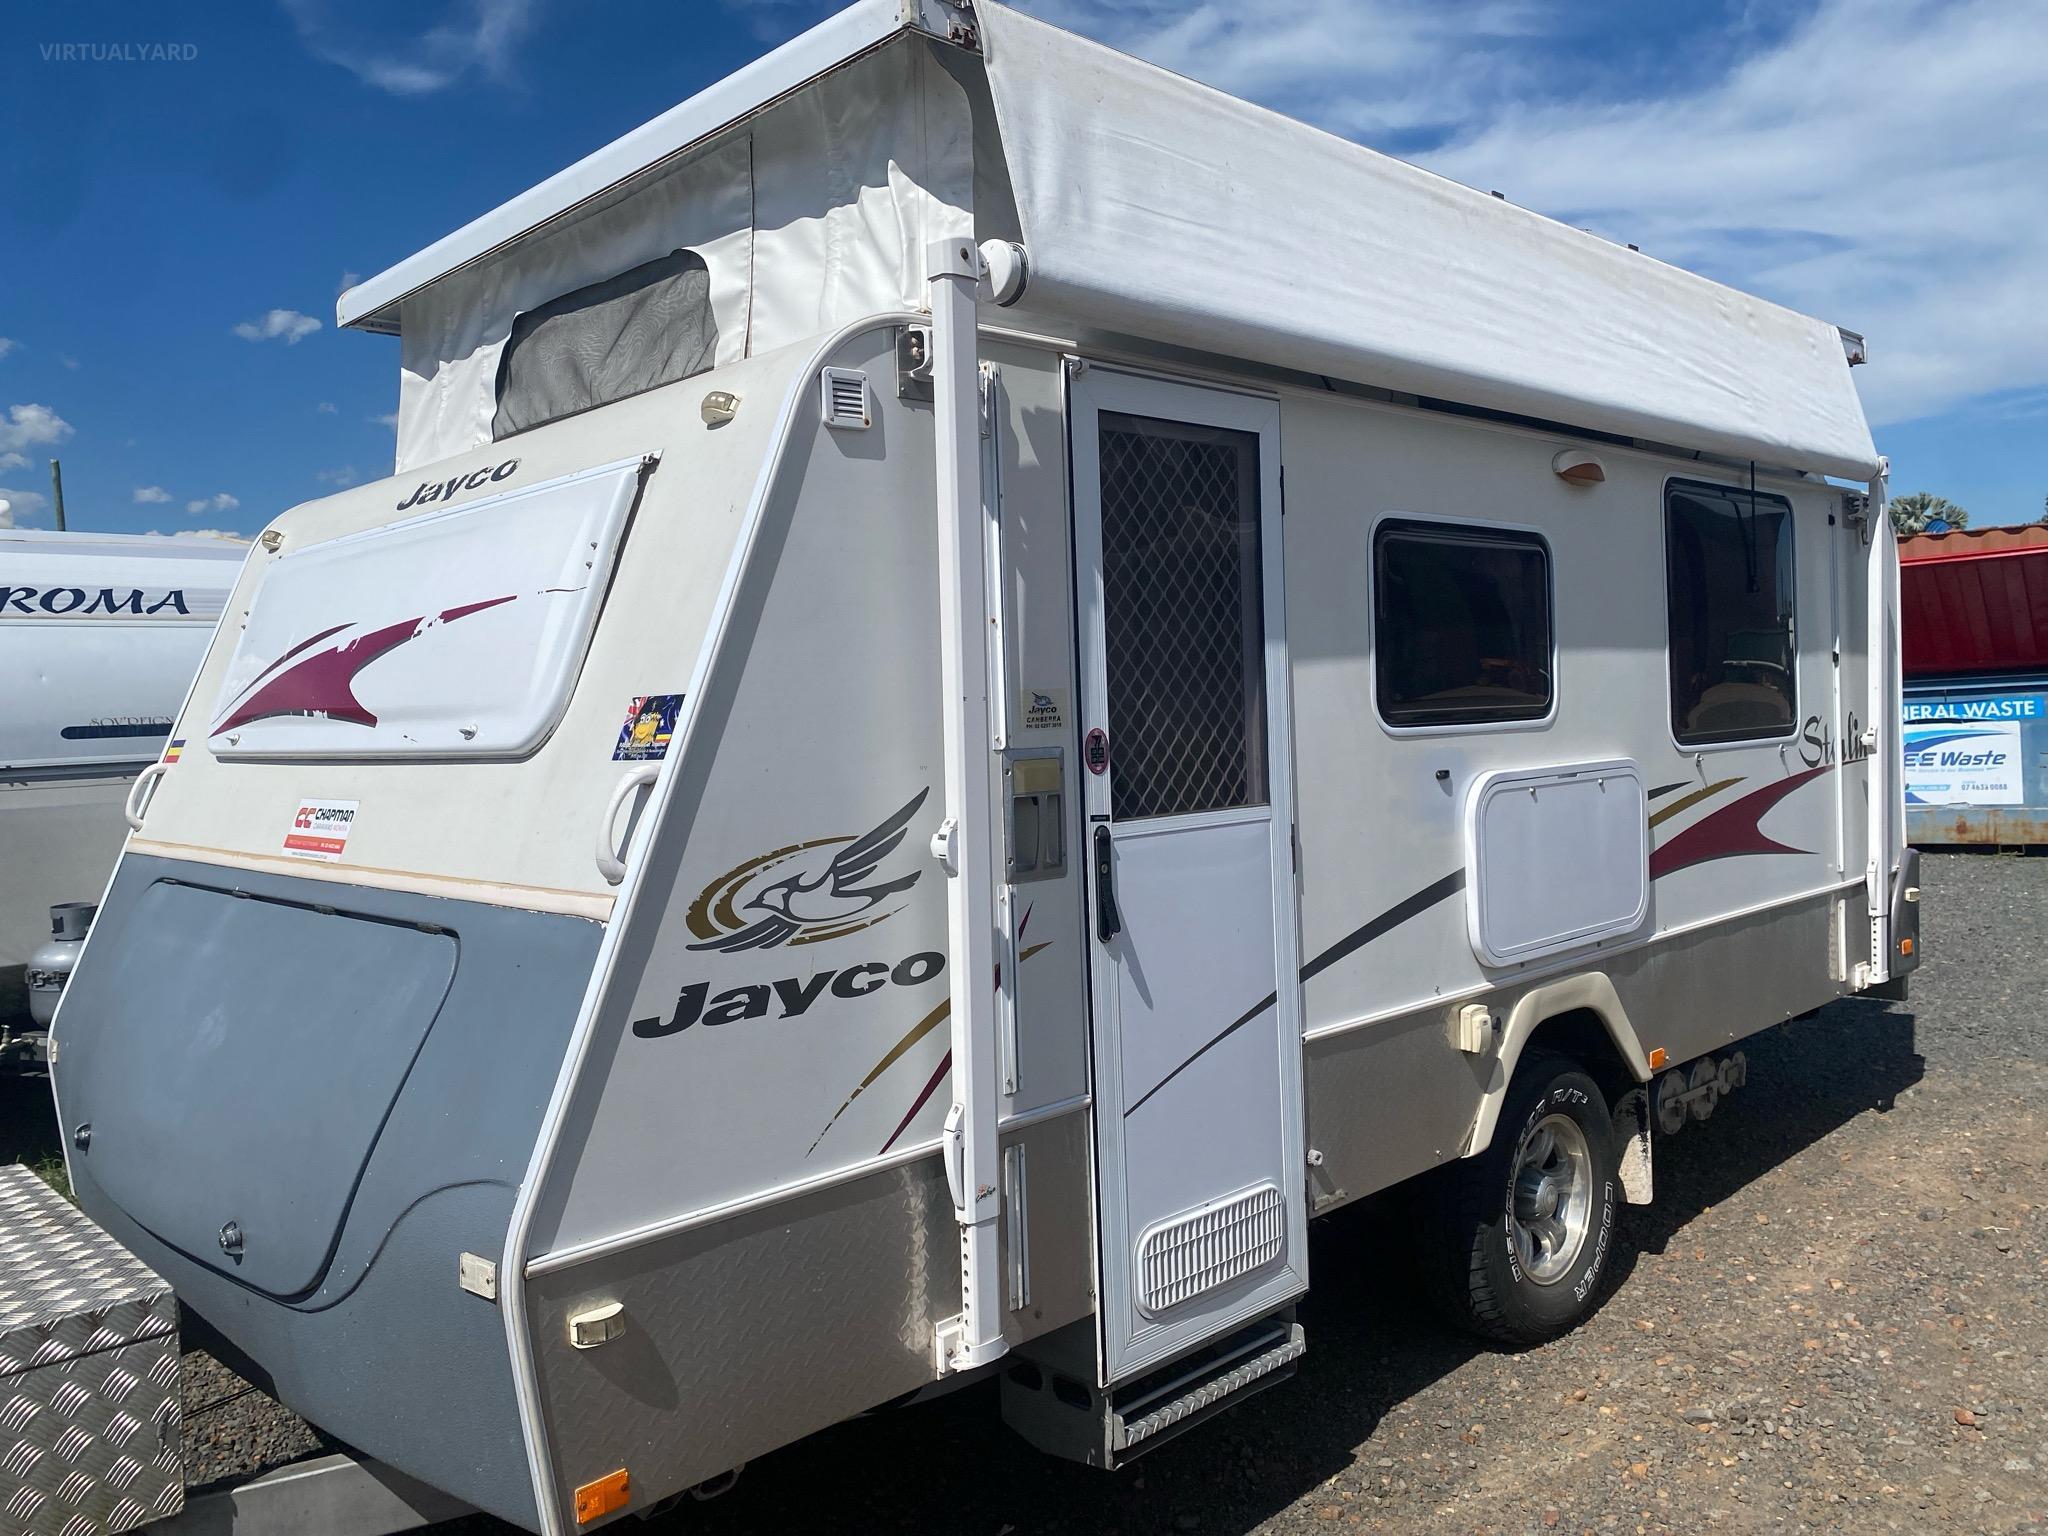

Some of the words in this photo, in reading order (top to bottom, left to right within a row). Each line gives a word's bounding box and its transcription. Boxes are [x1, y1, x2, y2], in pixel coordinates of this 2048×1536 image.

[396, 458, 521, 511] Jayco
[0, 586, 190, 615] ROMA
[1028, 706, 1057, 715] Jayco
[1962, 700, 2035, 718] WASTE
[1026, 716, 1061, 724] CANBERRA
[1940, 749, 2006, 767] Waste
[315, 808, 354, 823] CHAPMAN
[632, 952, 946, 1039] Jayco
[1574, 1181, 1613, 1303] COOPER
